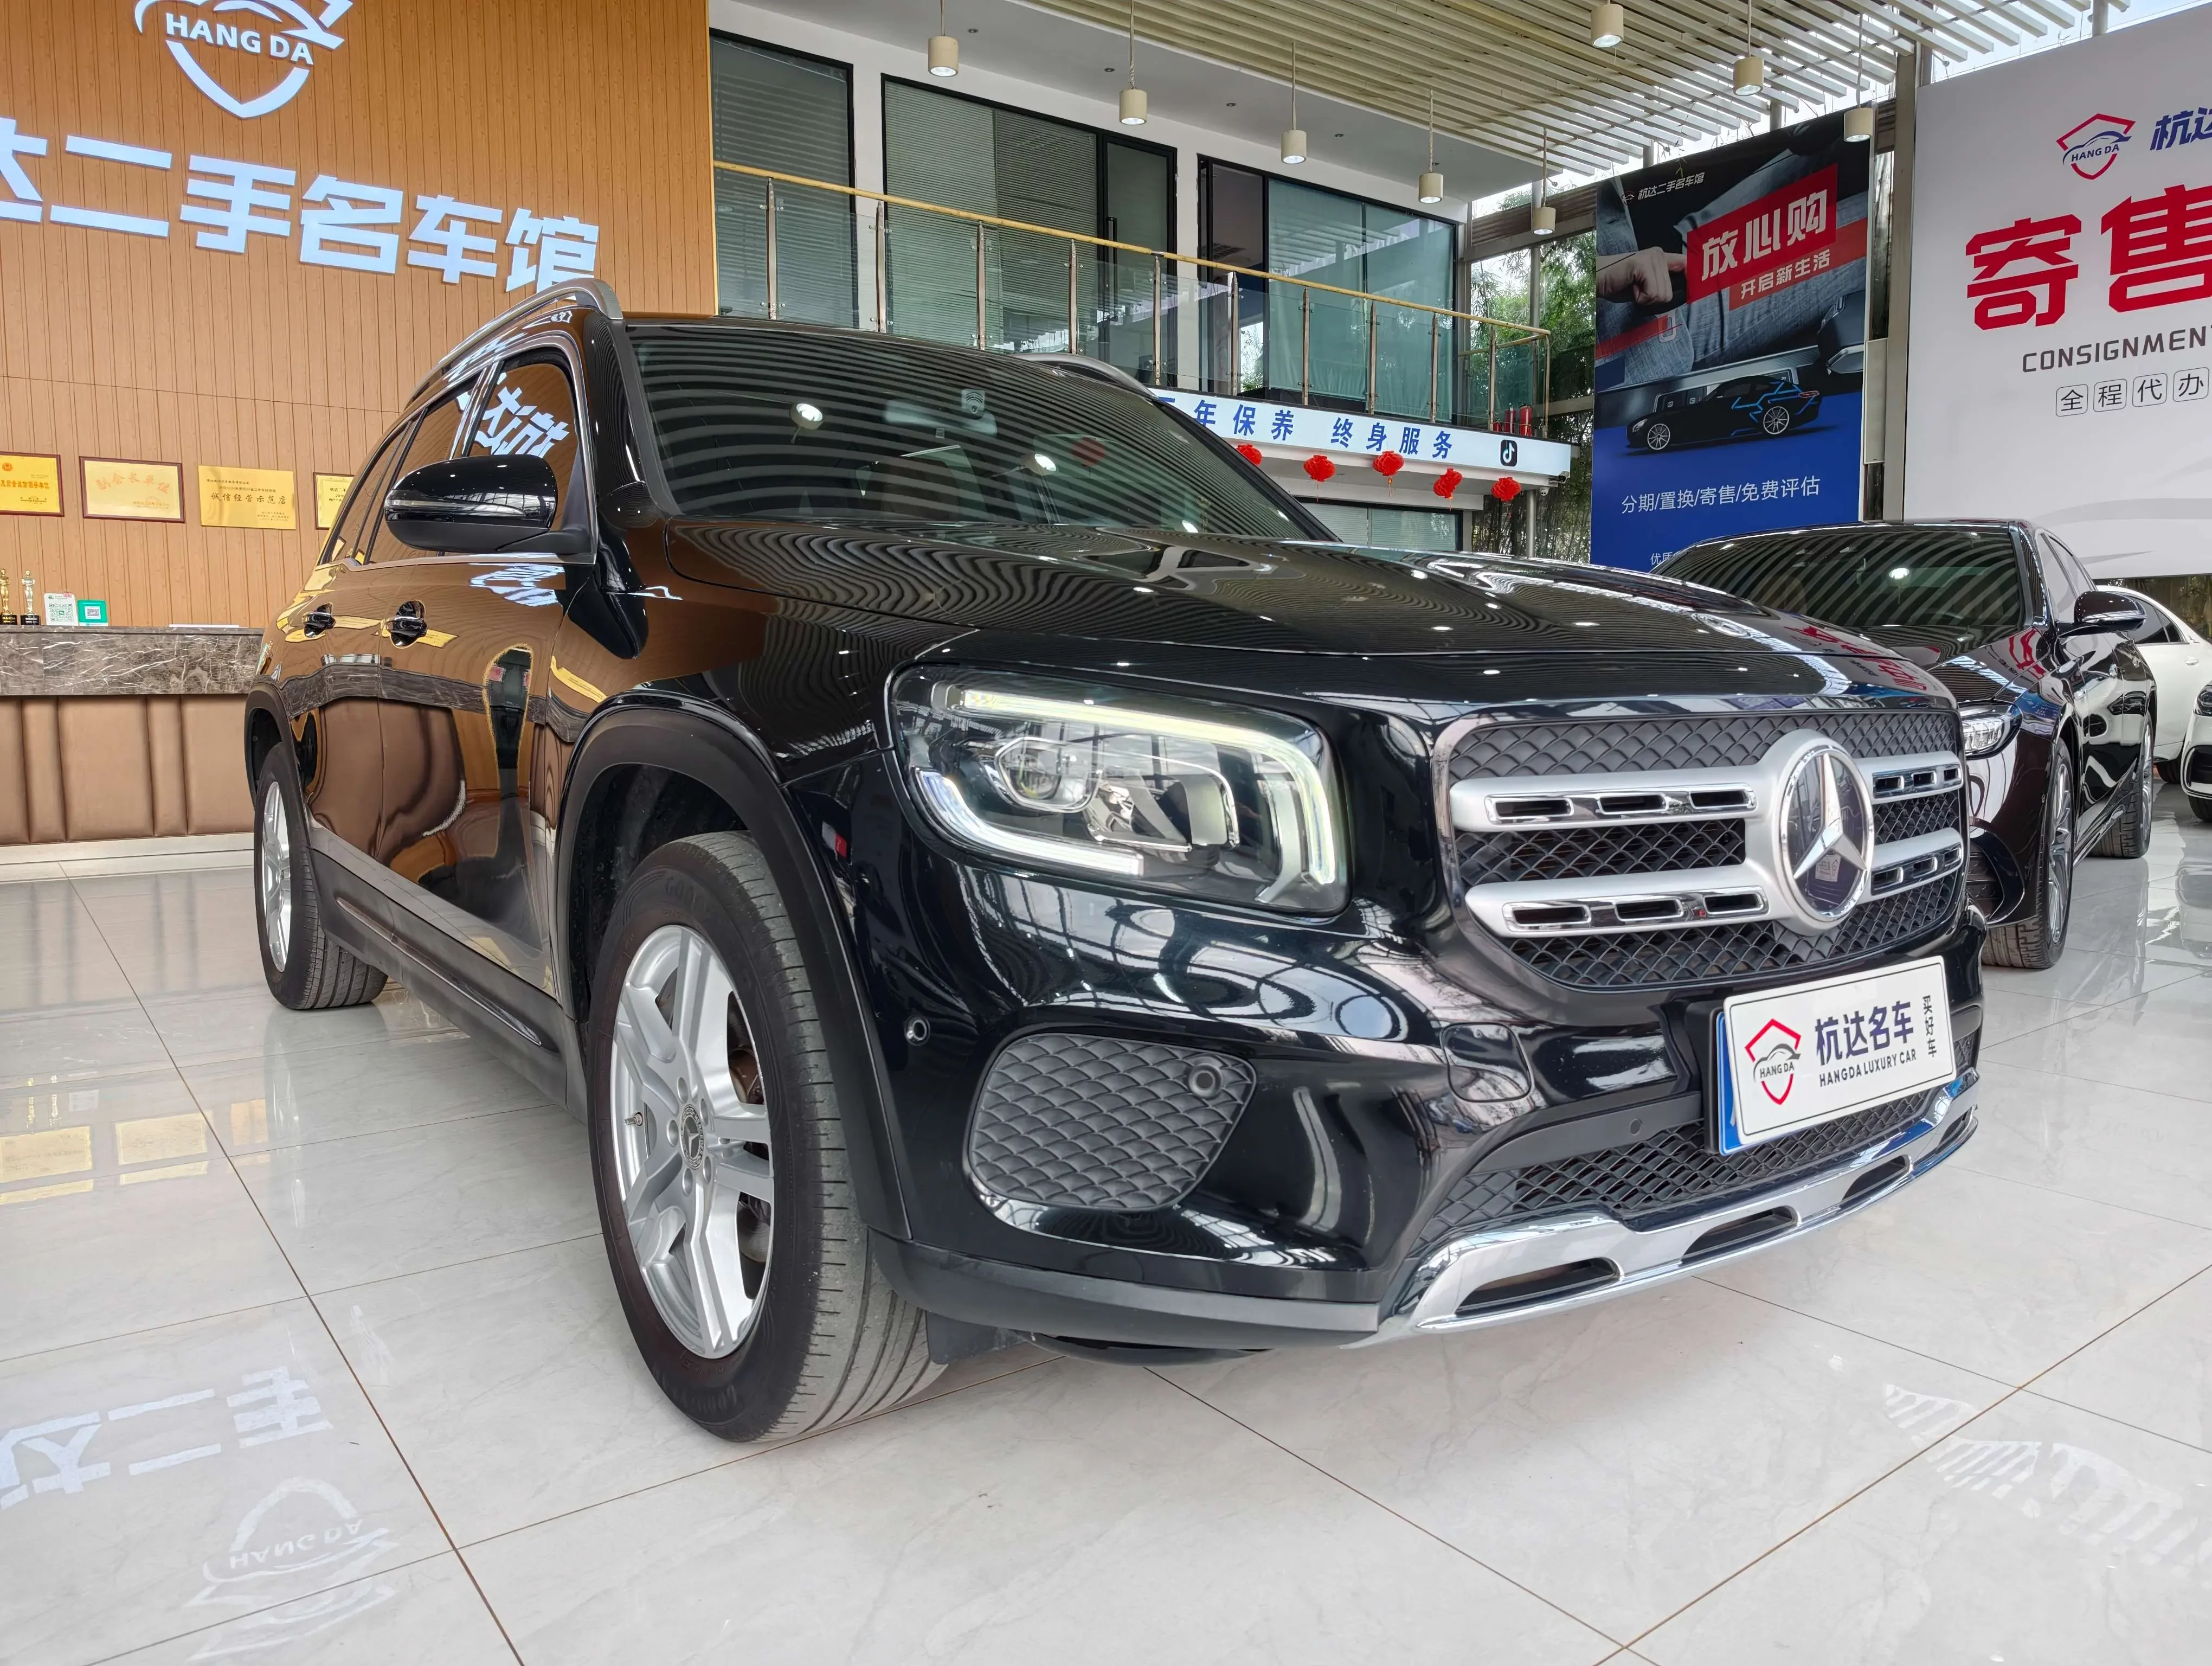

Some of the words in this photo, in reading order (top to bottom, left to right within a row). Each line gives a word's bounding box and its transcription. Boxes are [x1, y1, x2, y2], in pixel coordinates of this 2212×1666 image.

[166, 12, 261, 53] HANG
[270, 35, 314, 65] DA
[2071, 148, 2102, 162] HANG
[2104, 144, 2120, 155] DA
[1637, 172, 1705, 200] 杭达二手名车馆
[1702, 189, 1827, 281] 放心购
[1741, 249, 1830, 299] 开启新生活
[1965, 184, 2212, 330] 寄售
[2023, 325, 2212, 373] CONSIGNMEN
[2060, 373, 2204, 412] 全程代办
[1158, 396, 1294, 441] 年保养
[1330, 416, 1453, 459] 终身服务
[95, 471, 170, 494] 副会长单位
[210, 492, 287, 505] 诚信经营示范店
[1622, 475, 1821, 514] 分期/置换/寄售/免费评估
[1815, 1001, 1914, 1066] 杭达名车
[1922, 995, 1937, 1058] 买好车
[1760, 1063, 1783, 1079] HANG
[1784, 1061, 1795, 1072] DA
[1819, 1064, 1862, 1087] HANGDA
[1863, 1053, 1897, 1074] LUXURY
[1899, 1048, 1917, 1064] CAR
